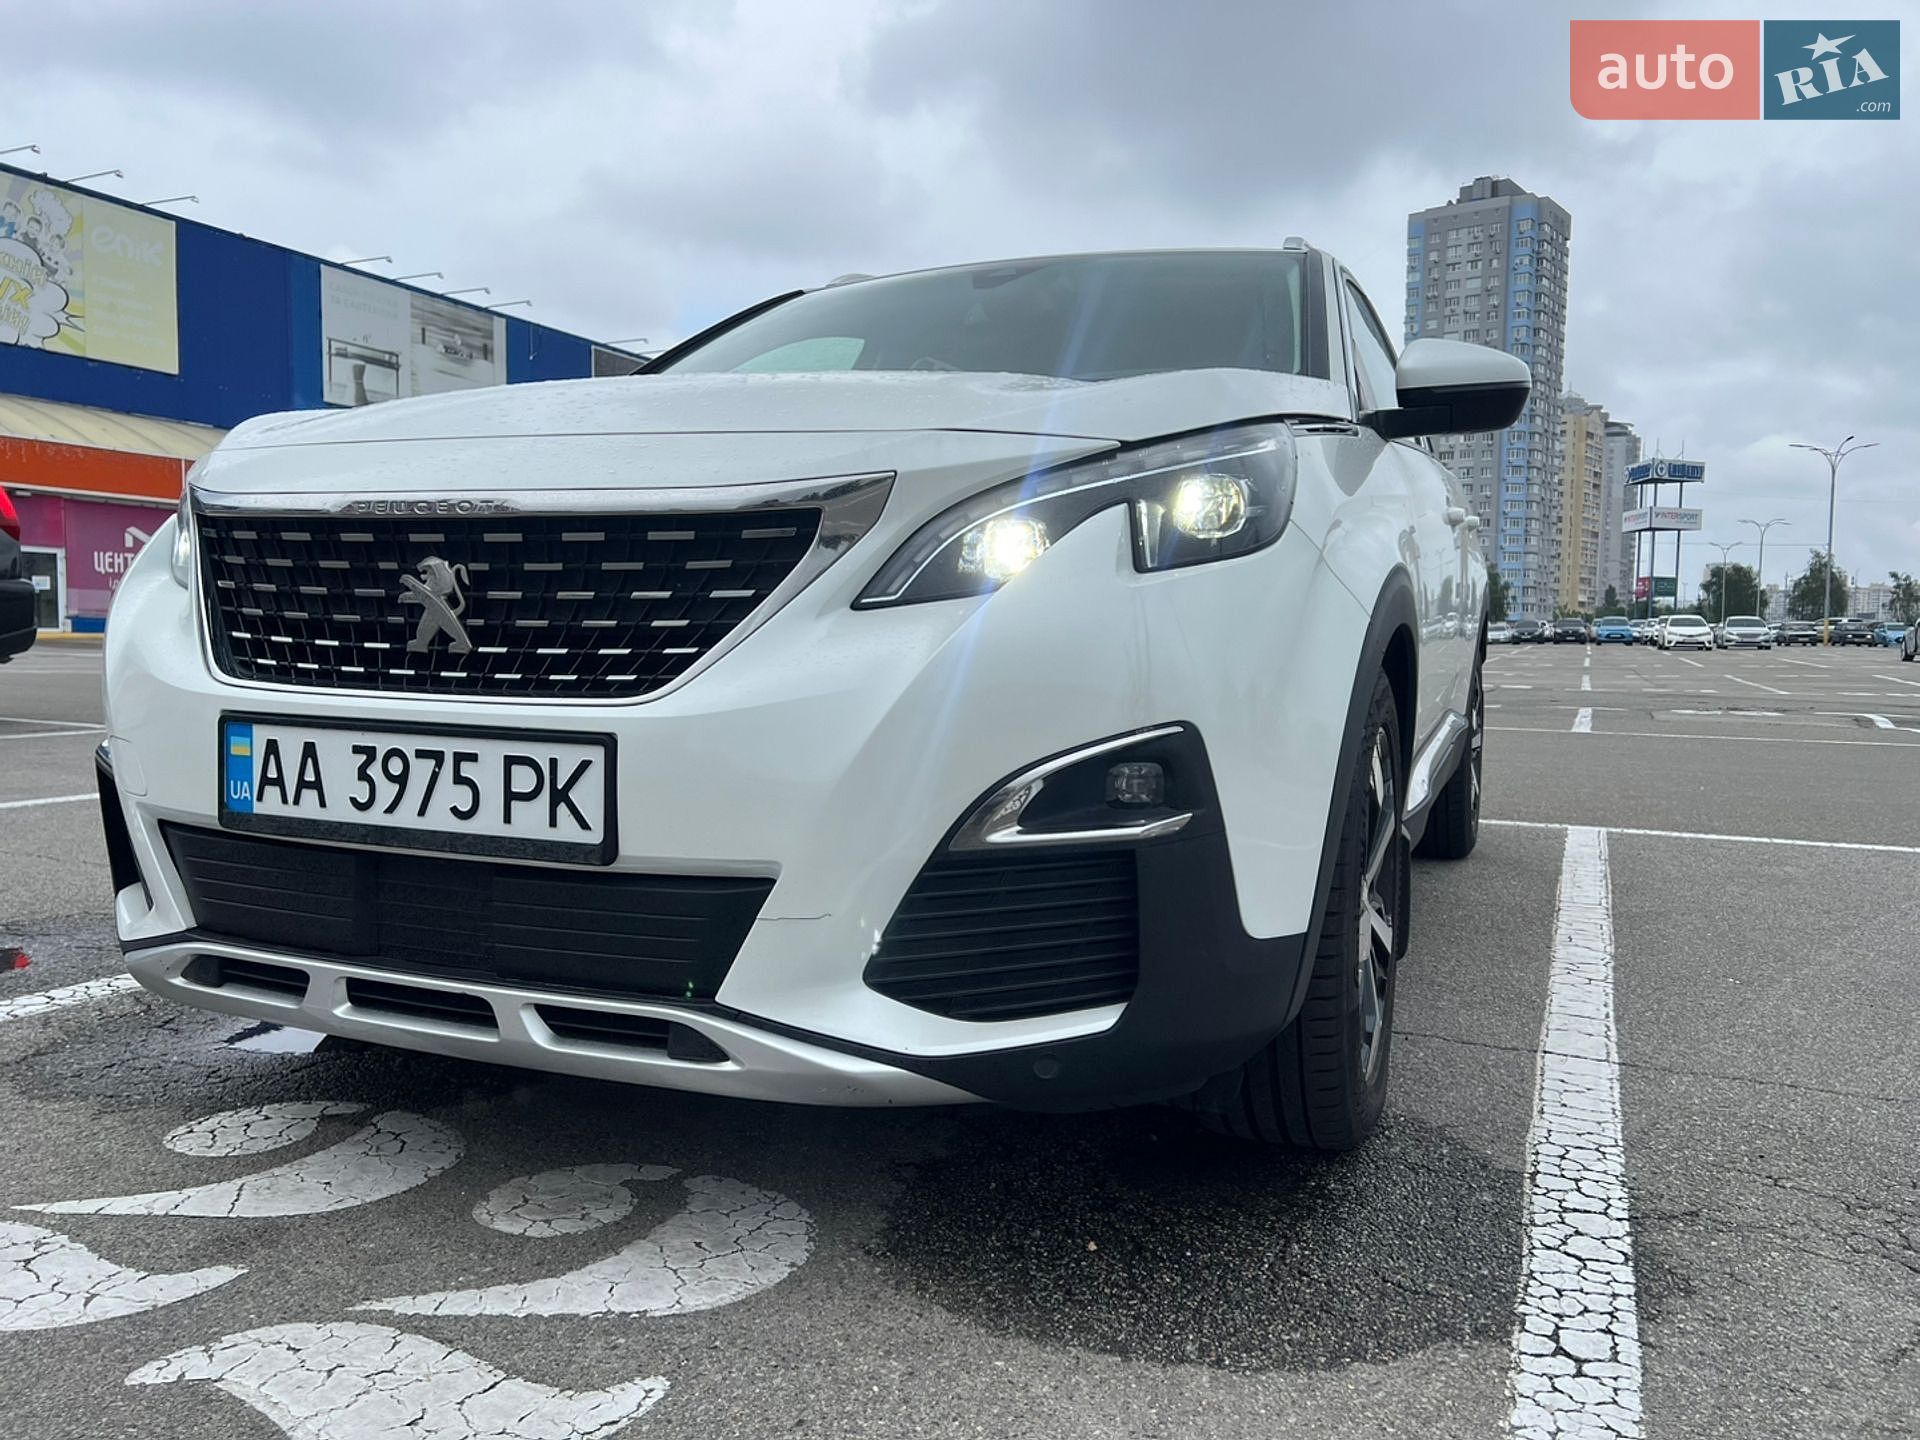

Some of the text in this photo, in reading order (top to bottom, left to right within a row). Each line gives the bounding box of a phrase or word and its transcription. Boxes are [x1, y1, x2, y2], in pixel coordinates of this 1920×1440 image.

[230, 780, 251, 801] UA
[256, 738, 593, 831] AA 3975 PK
